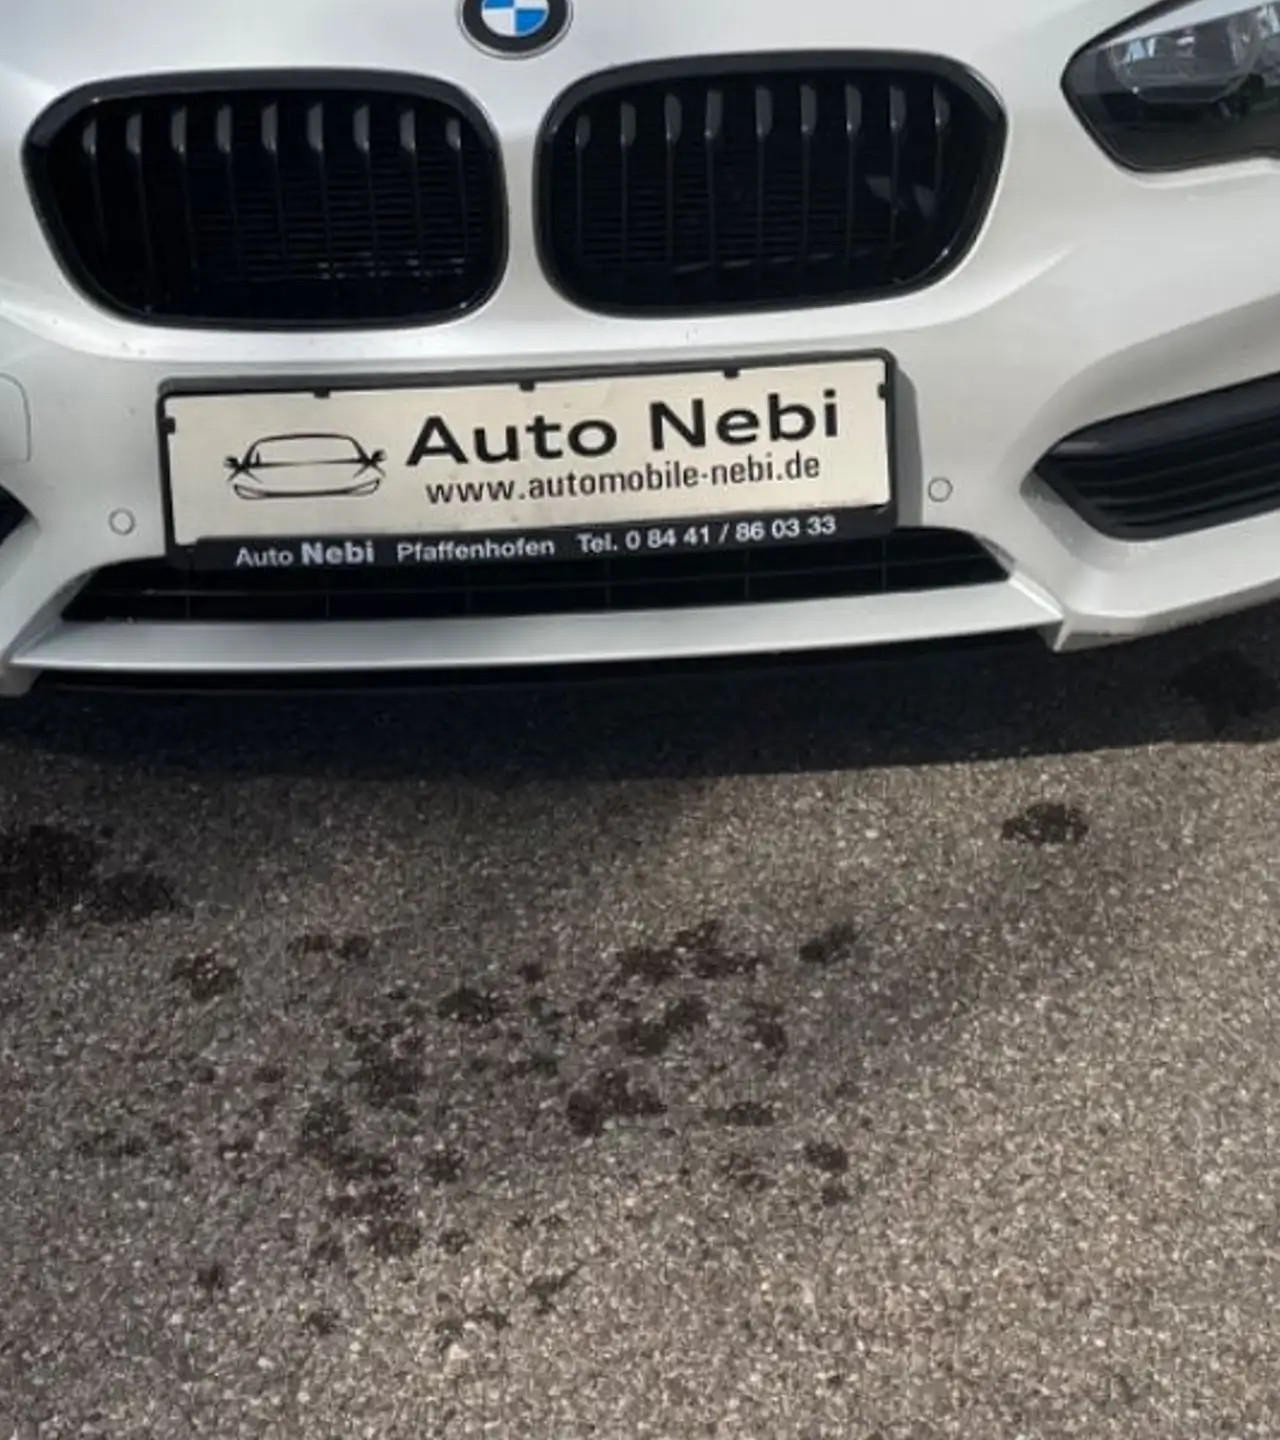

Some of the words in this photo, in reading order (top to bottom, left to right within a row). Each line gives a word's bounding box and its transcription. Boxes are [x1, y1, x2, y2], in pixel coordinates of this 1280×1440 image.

[404, 415, 618, 466] Auto
[649, 389, 839, 451] Nebi
[425, 449, 821, 505] www.automobile-nebi.de
[235, 545, 294, 568] Auto
[300, 540, 376, 566] Nebi
[396, 537, 556, 563] Pfaffenhofen
[576, 532, 619, 554] Tel.
[624, 530, 642, 551] 0
[647, 527, 677, 549] 84
[683, 524, 710, 546] 41
[735, 520, 765, 542] 86
[771, 517, 801, 539] 03
[806, 514, 837, 536] 33
